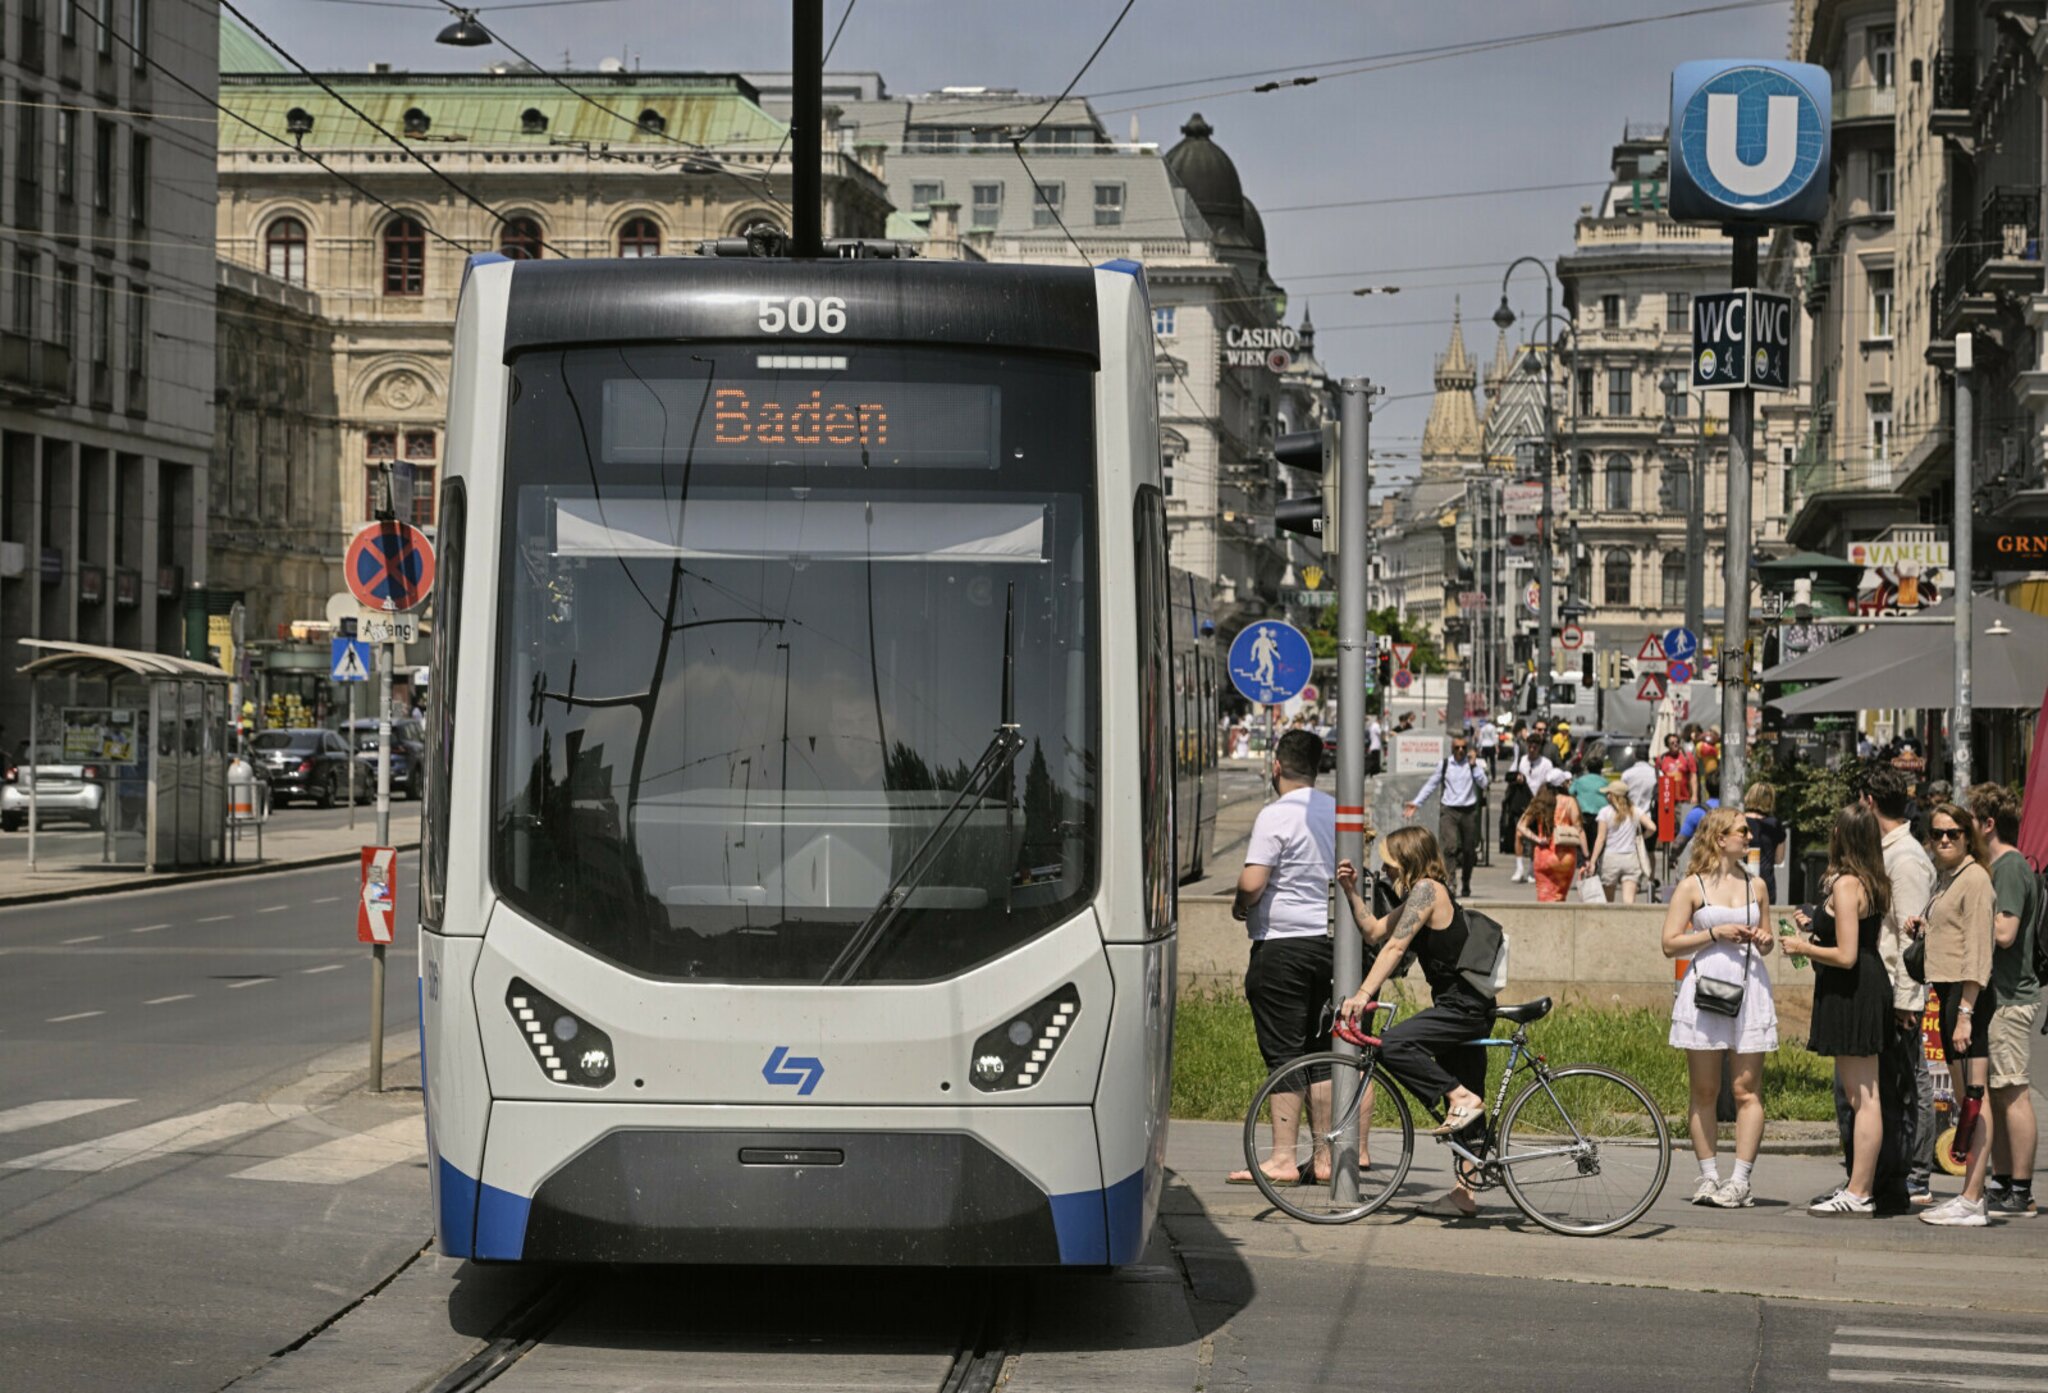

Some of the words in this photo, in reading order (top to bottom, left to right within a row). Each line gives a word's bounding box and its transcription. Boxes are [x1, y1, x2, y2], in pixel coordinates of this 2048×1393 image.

[1706, 93, 1799, 196] U
[758, 296, 847, 334] 506
[1226, 324, 1295, 349] CASINO
[1698, 298, 1744, 343] WC
[1755, 299, 1789, 346] WC
[1226, 350, 1266, 367] WIEN
[715, 389, 887, 444] Baden
